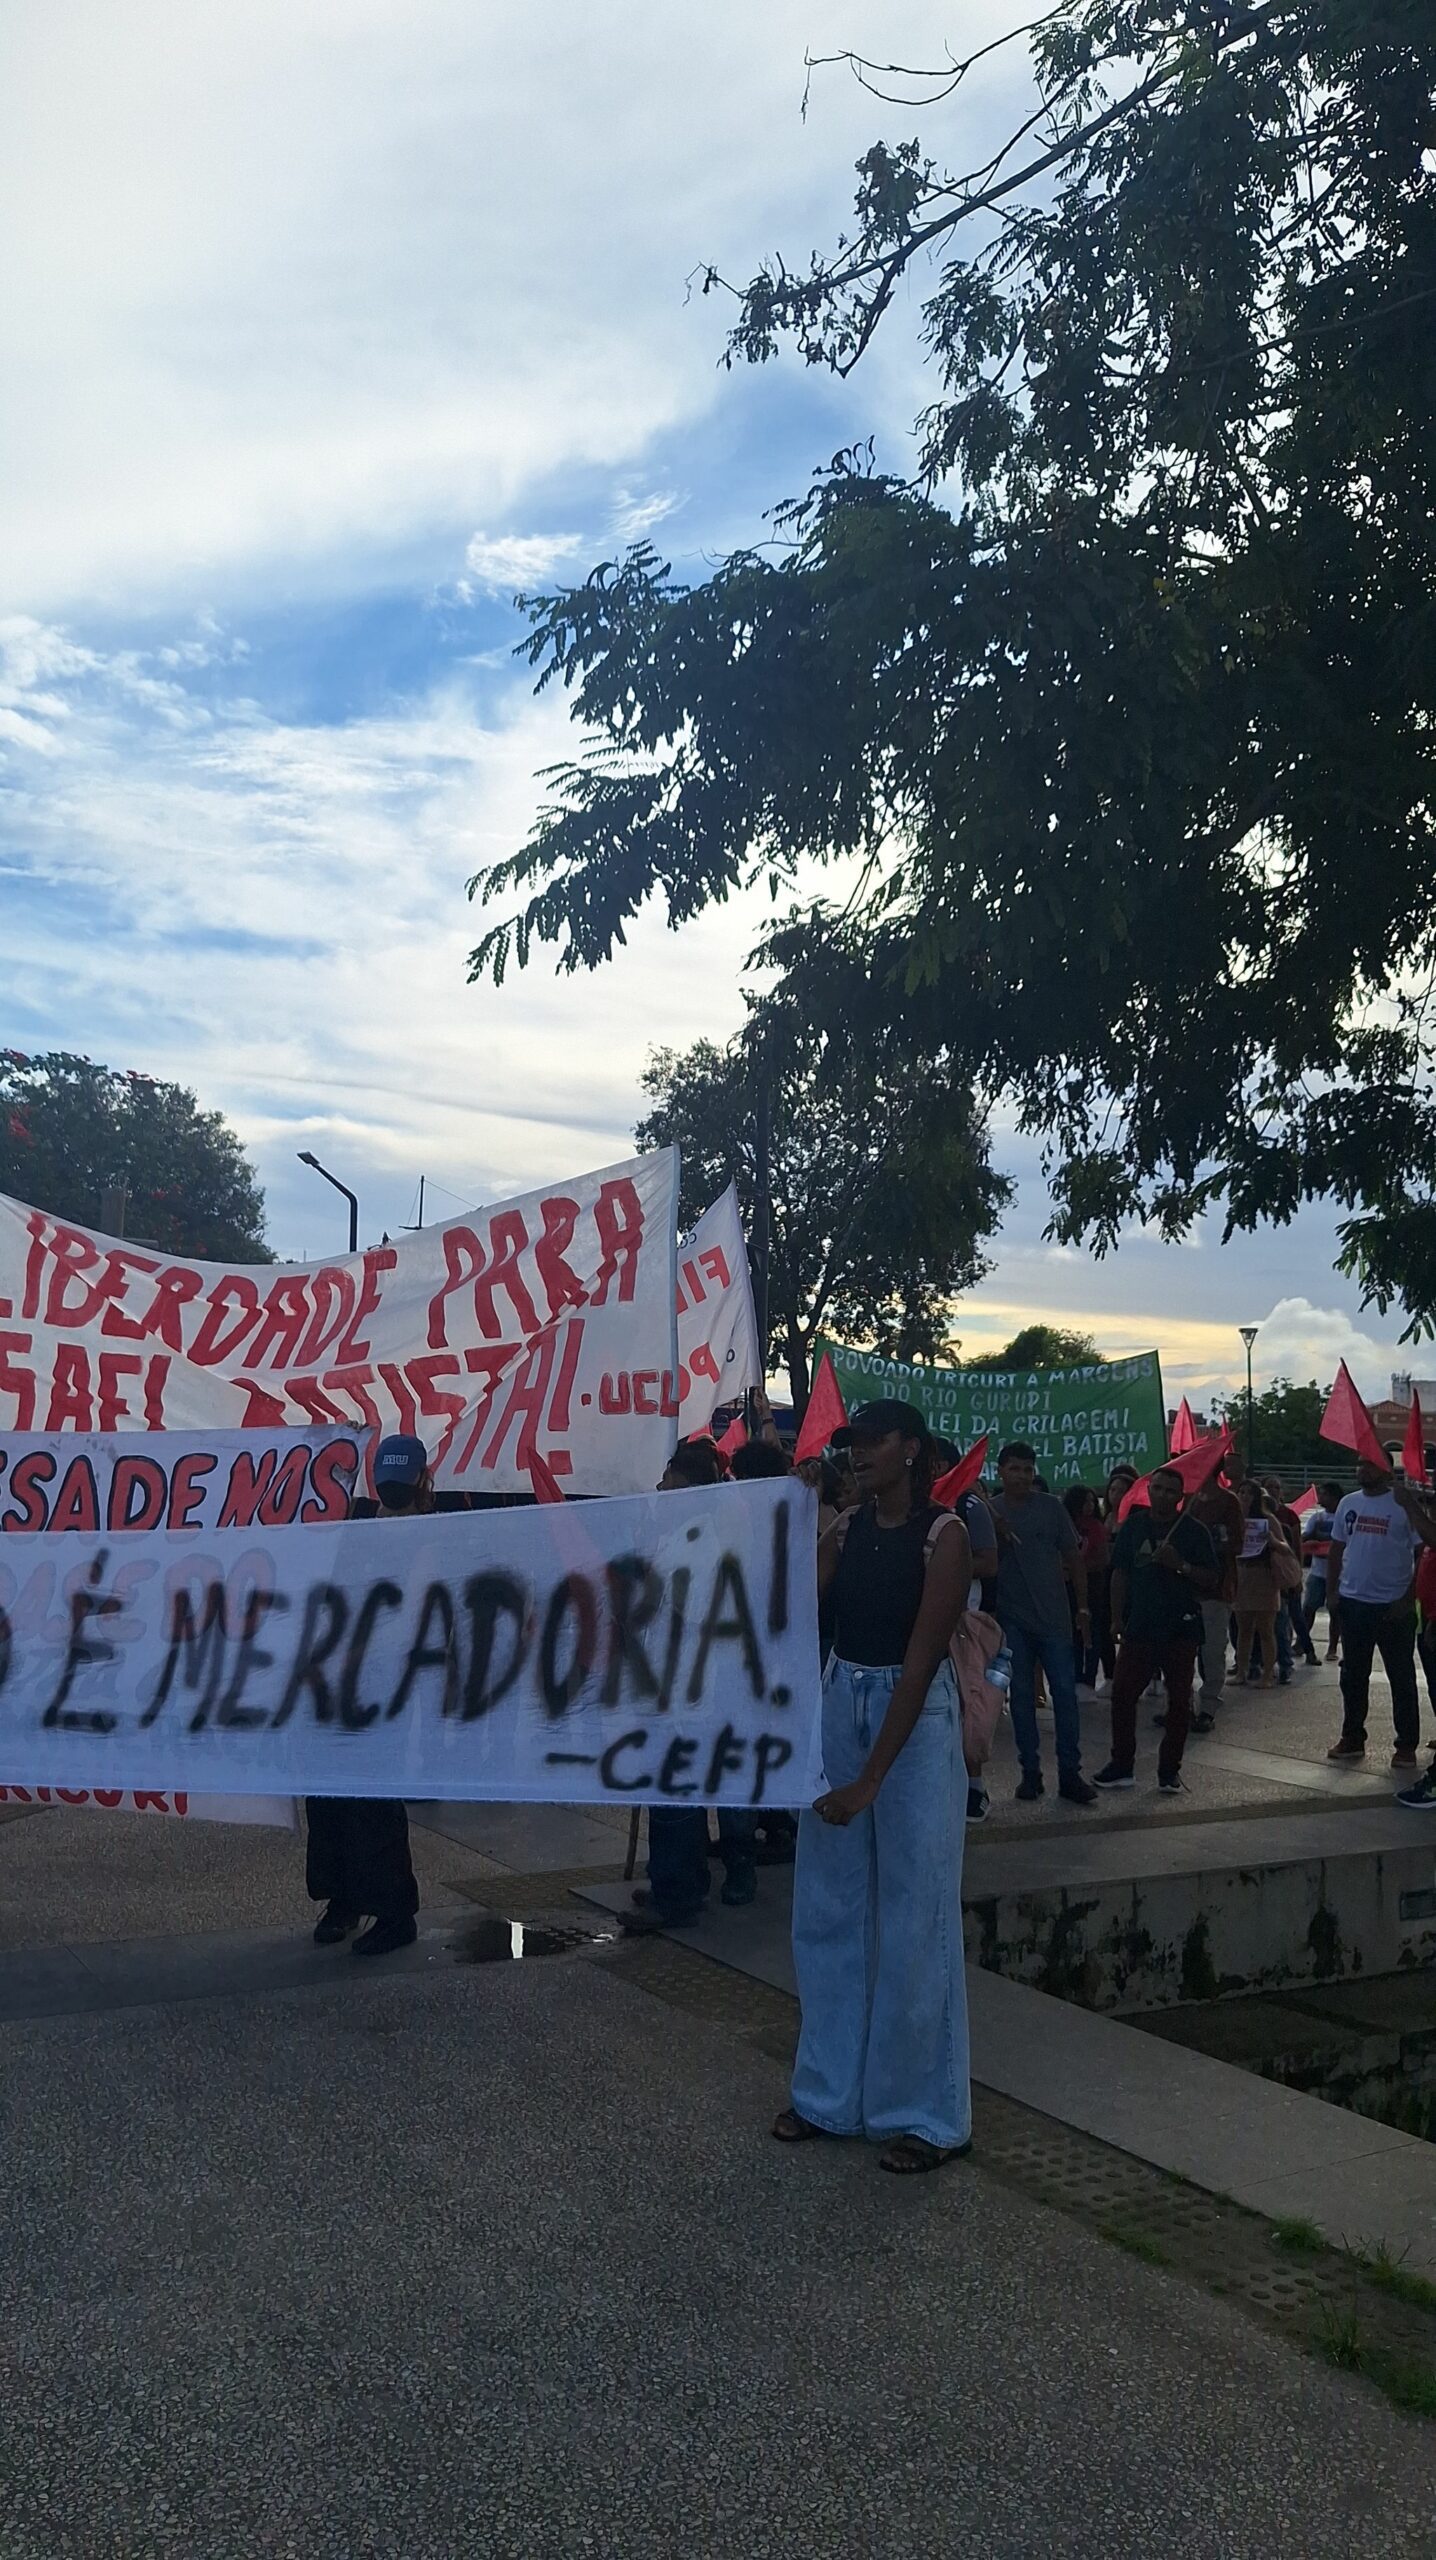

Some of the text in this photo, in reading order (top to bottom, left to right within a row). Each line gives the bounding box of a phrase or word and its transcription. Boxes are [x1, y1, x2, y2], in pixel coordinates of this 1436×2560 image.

[428, 1177, 644, 1349] PARA
[832, 1347, 926, 1381] POVOADO
[1026, 1373, 1039, 1386] A
[883, 1380, 1051, 1413] DO RIO GURUPI
[928, 1411, 961, 1433] LEI
[971, 1415, 1000, 1435] DA
[1062, 1432, 1149, 1457] BATISTA
[42, 1548, 122, 1734] É
